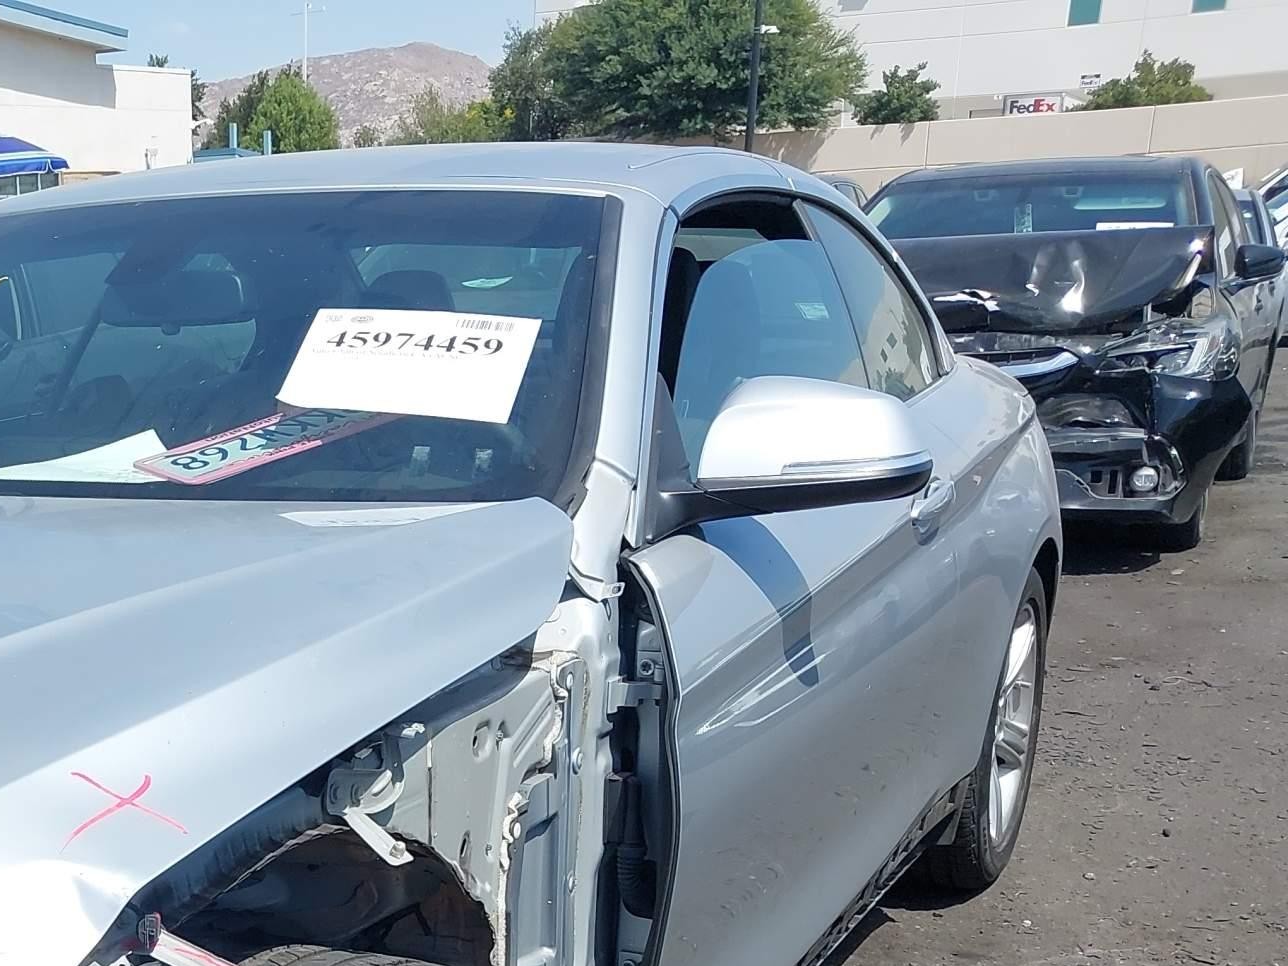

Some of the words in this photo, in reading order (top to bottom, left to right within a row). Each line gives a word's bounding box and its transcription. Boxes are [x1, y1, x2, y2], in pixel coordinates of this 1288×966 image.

[1009, 99, 1056, 114] FedEx
[326, 330, 504, 356] 45974459
[169, 408, 357, 471] KKW268
